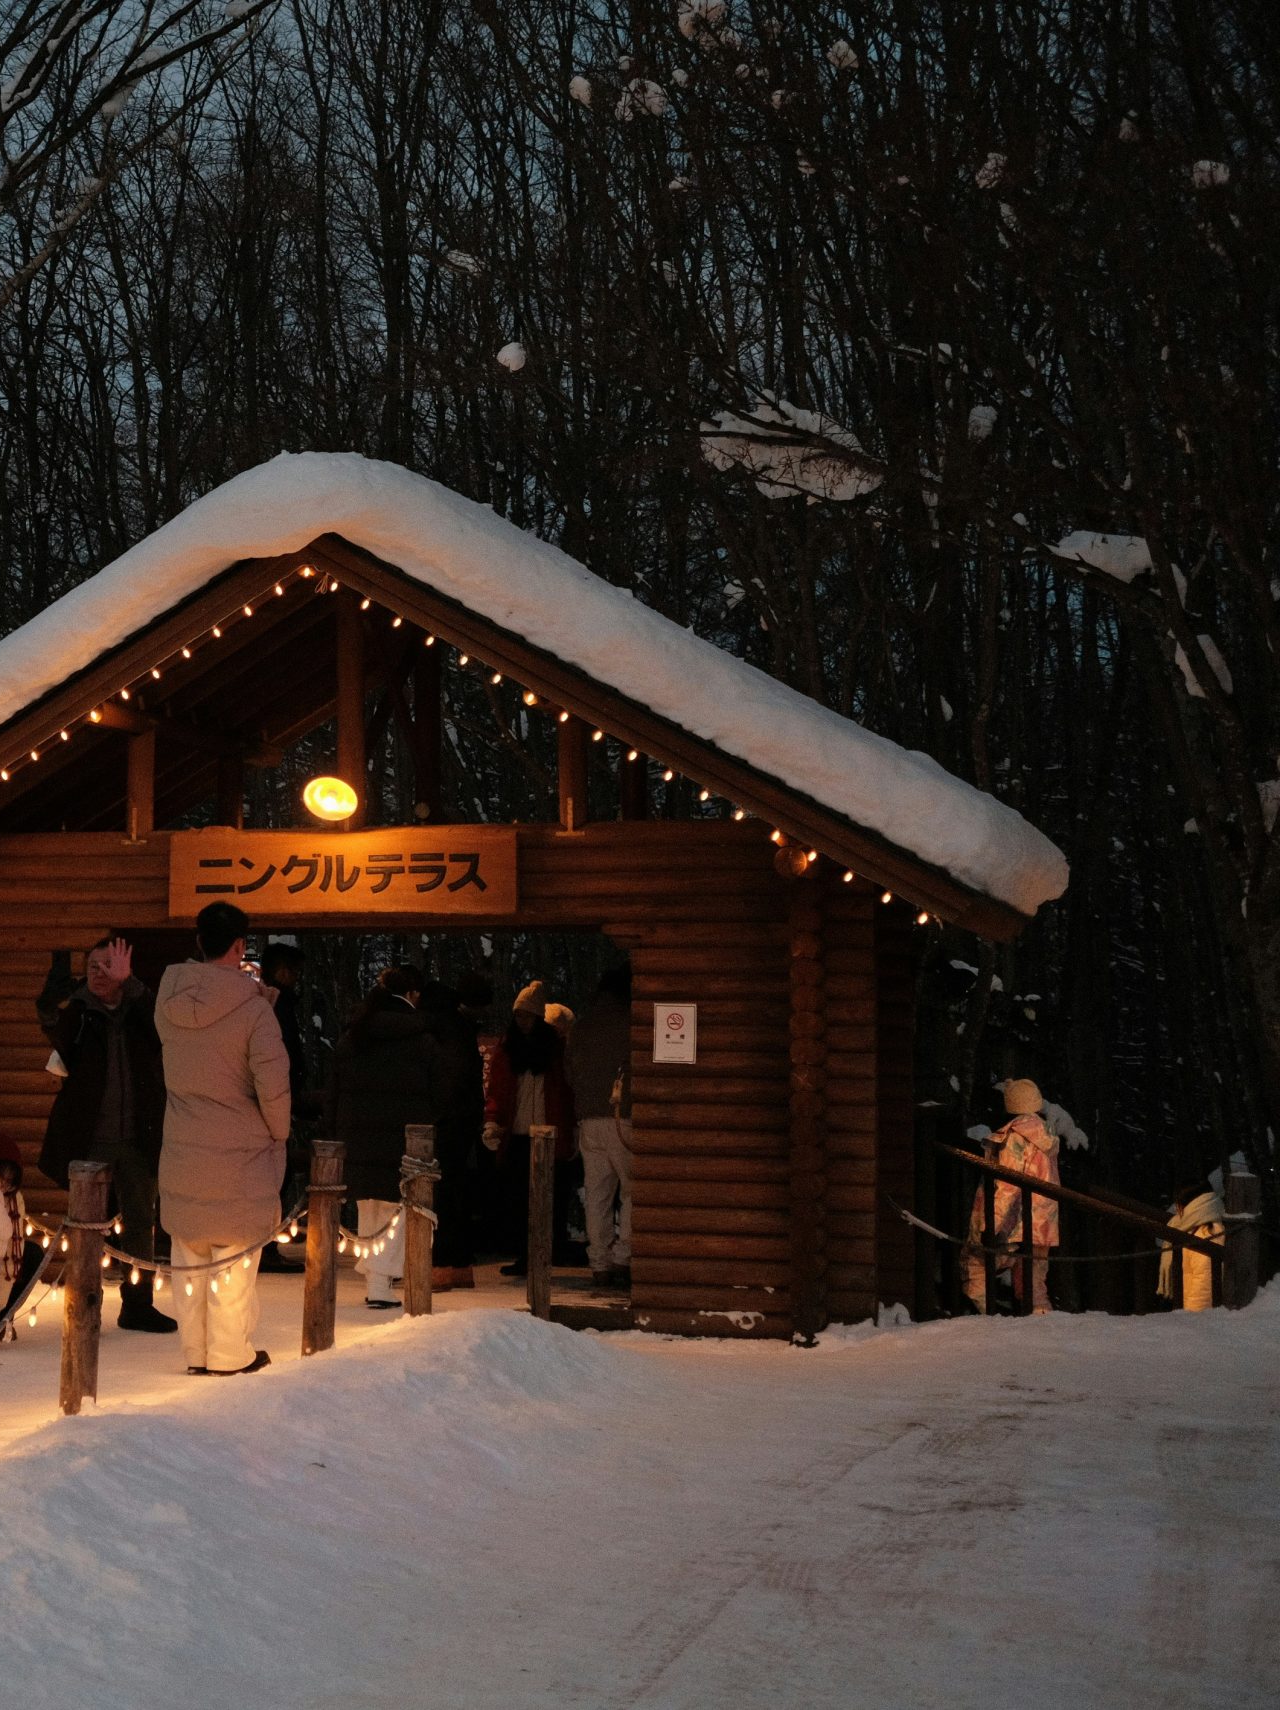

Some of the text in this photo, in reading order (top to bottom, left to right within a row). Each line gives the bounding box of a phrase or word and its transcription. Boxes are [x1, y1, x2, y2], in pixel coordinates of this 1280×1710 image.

[195, 853, 488, 894] ニングルテラス
